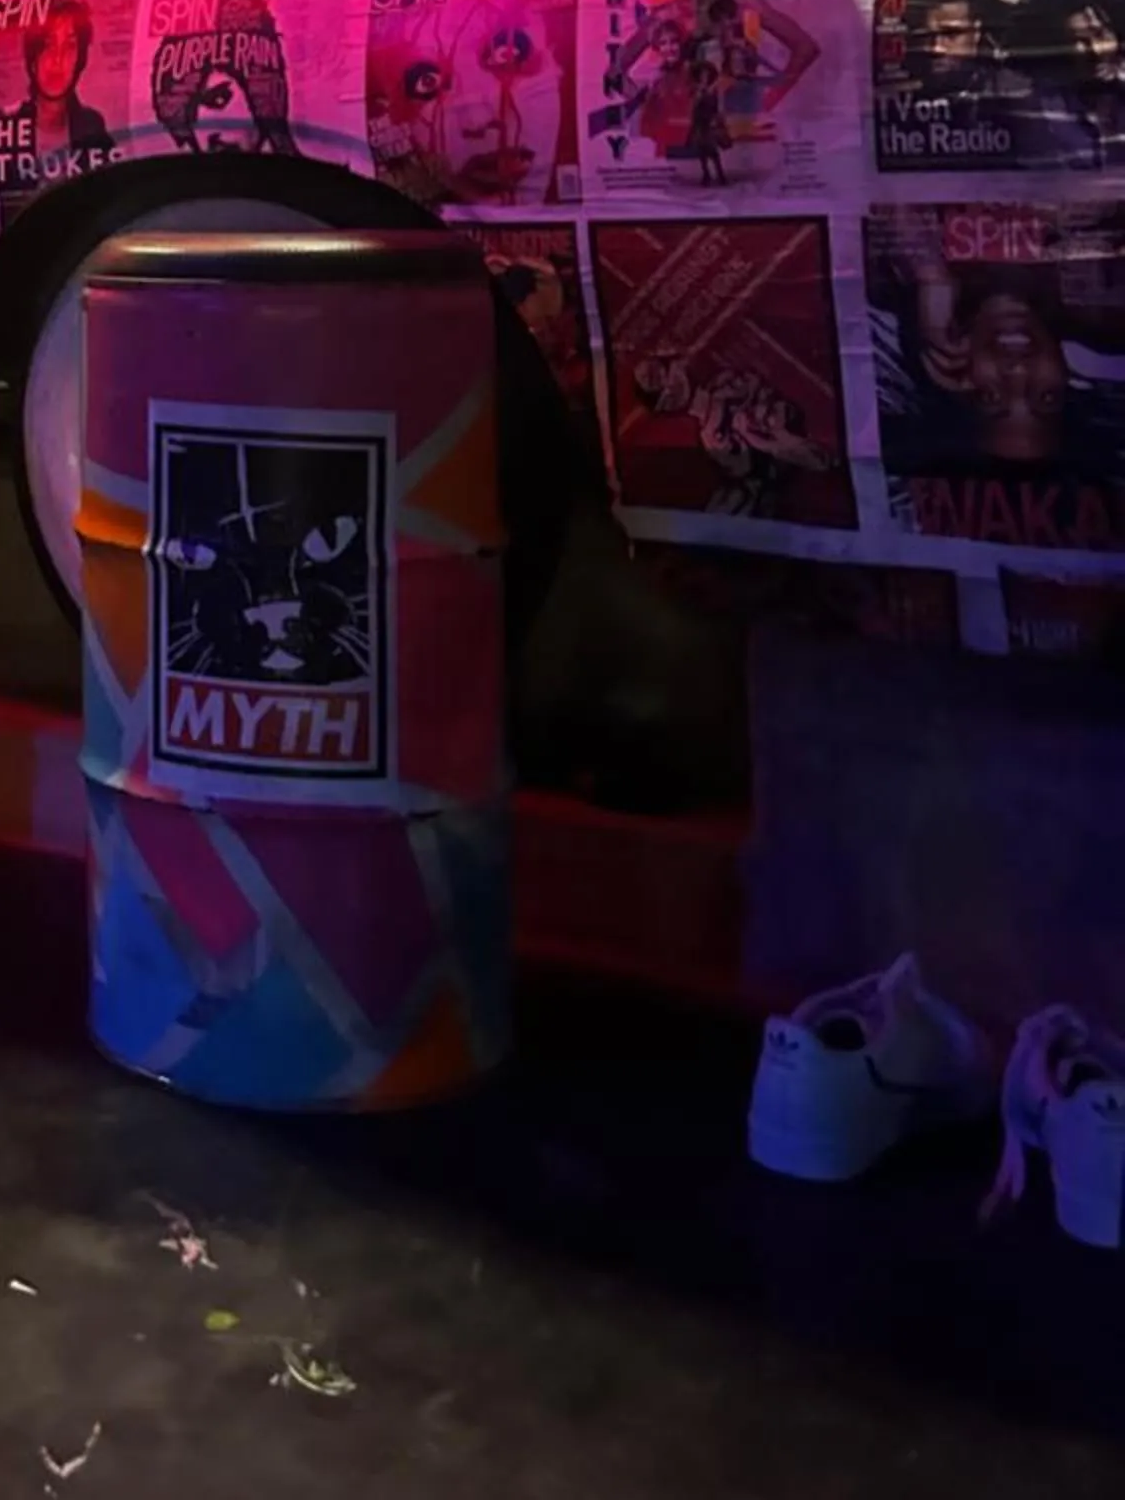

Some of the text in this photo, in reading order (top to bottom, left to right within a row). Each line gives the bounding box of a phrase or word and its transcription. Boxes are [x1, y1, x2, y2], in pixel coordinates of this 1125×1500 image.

[157, 32, 232, 94] PURPLE
[234, 31, 280, 79] RAIN
[915, 97, 952, 123] on
[880, 121, 1011, 155] the Radio
[948, 214, 1043, 261] SPIN
[169, 685, 360, 757] MYTH
